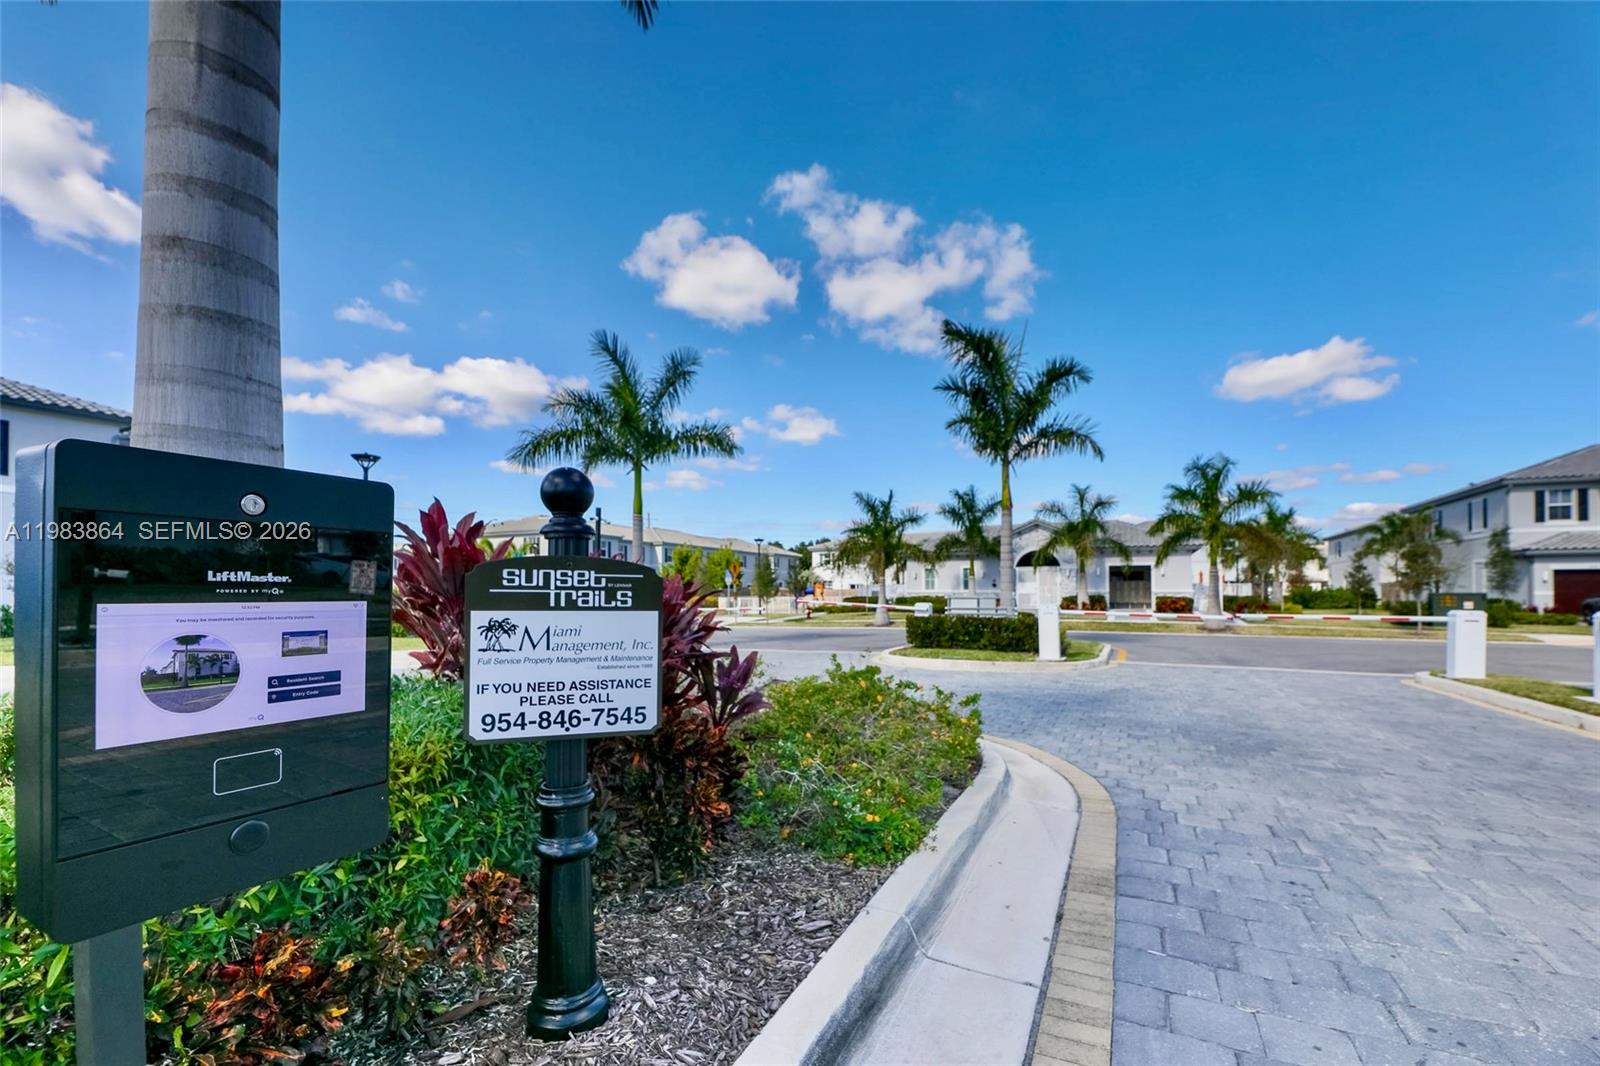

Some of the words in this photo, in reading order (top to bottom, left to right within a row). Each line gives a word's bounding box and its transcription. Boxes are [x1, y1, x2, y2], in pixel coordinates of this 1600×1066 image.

[518, 625, 582, 651] Miami
[632, 639, 654, 651] Inc.
[477, 657, 491, 665] Full
[493, 656, 522, 665] Service
[523, 655, 554, 664] Property
[555, 655, 602, 664] Management
[610, 654, 653, 662] Maintenance
[476, 684, 490, 694] IF
[492, 682, 522, 694] YOU
[526, 681, 566, 692] NEED
[568, 678, 652, 691] ASSISTANCE
[519, 695, 575, 707] PLEASE
[579, 693, 614, 704] CALL
[481, 706, 647, 733] 954-846-7545
